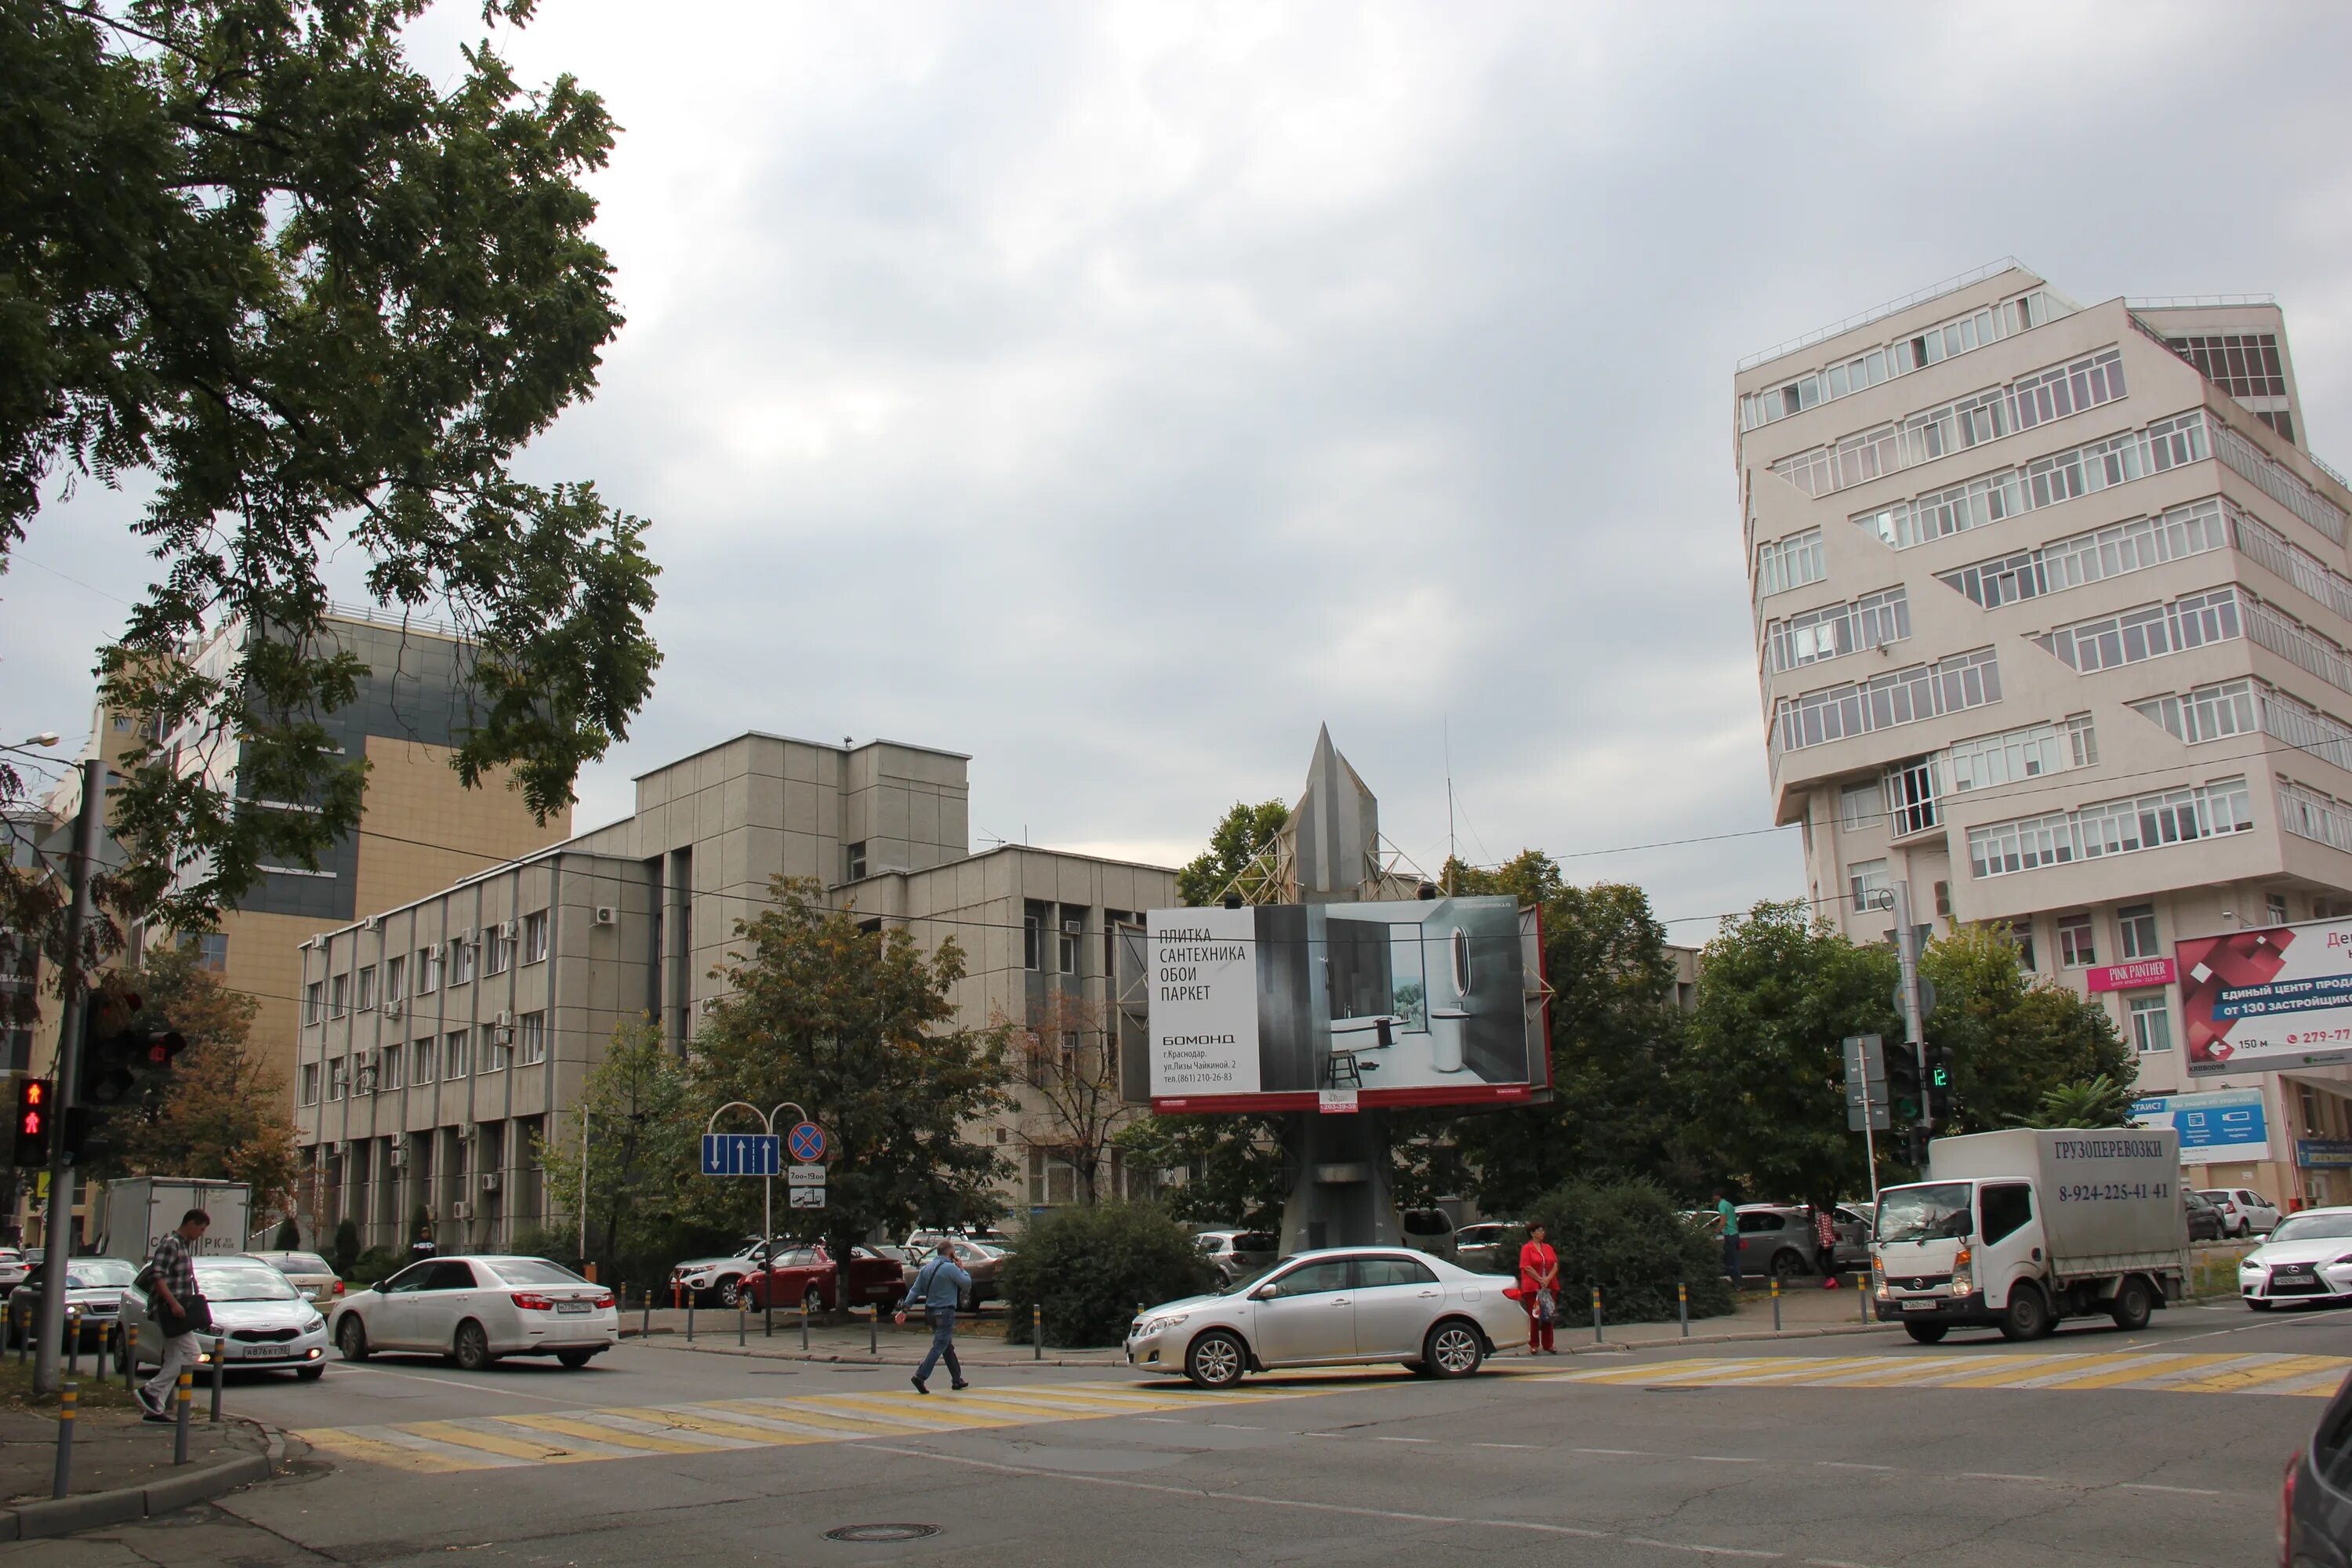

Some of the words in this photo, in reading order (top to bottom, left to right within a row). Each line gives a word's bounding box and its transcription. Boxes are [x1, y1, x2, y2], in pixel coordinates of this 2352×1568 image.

[1160, 927, 1211, 944] ПЛИТКА
[2327, 932, 2352, 949] Де
[1160, 946, 1246, 963] САНТЕХНИКА
[1160, 967, 1196, 982] ОБОИ
[2109, 966, 2129, 982] PINK
[2129, 961, 2166, 979] PANTHER
[1161, 985, 1211, 1002] ПАРКЕТ
[2221, 985, 2272, 1000] ЕДИНЫЙ
[2274, 982, 2313, 994] ЦЕНТР
[2241, 1002, 2265, 1014] 130
[1163, 1034, 1236, 1046] БОМОНД
[2238, 1039, 2257, 1049] 150
[1232, 1060, 1236, 1069] 2
[1164, 1074, 1196, 1083] тел.(861)
[1197, 1073, 1232, 1082] 210-26-83
[1934, 1069, 1947, 1086] 12
[2055, 1140, 2163, 1160] ГРУЗОПЕРЕВОЗКИ
